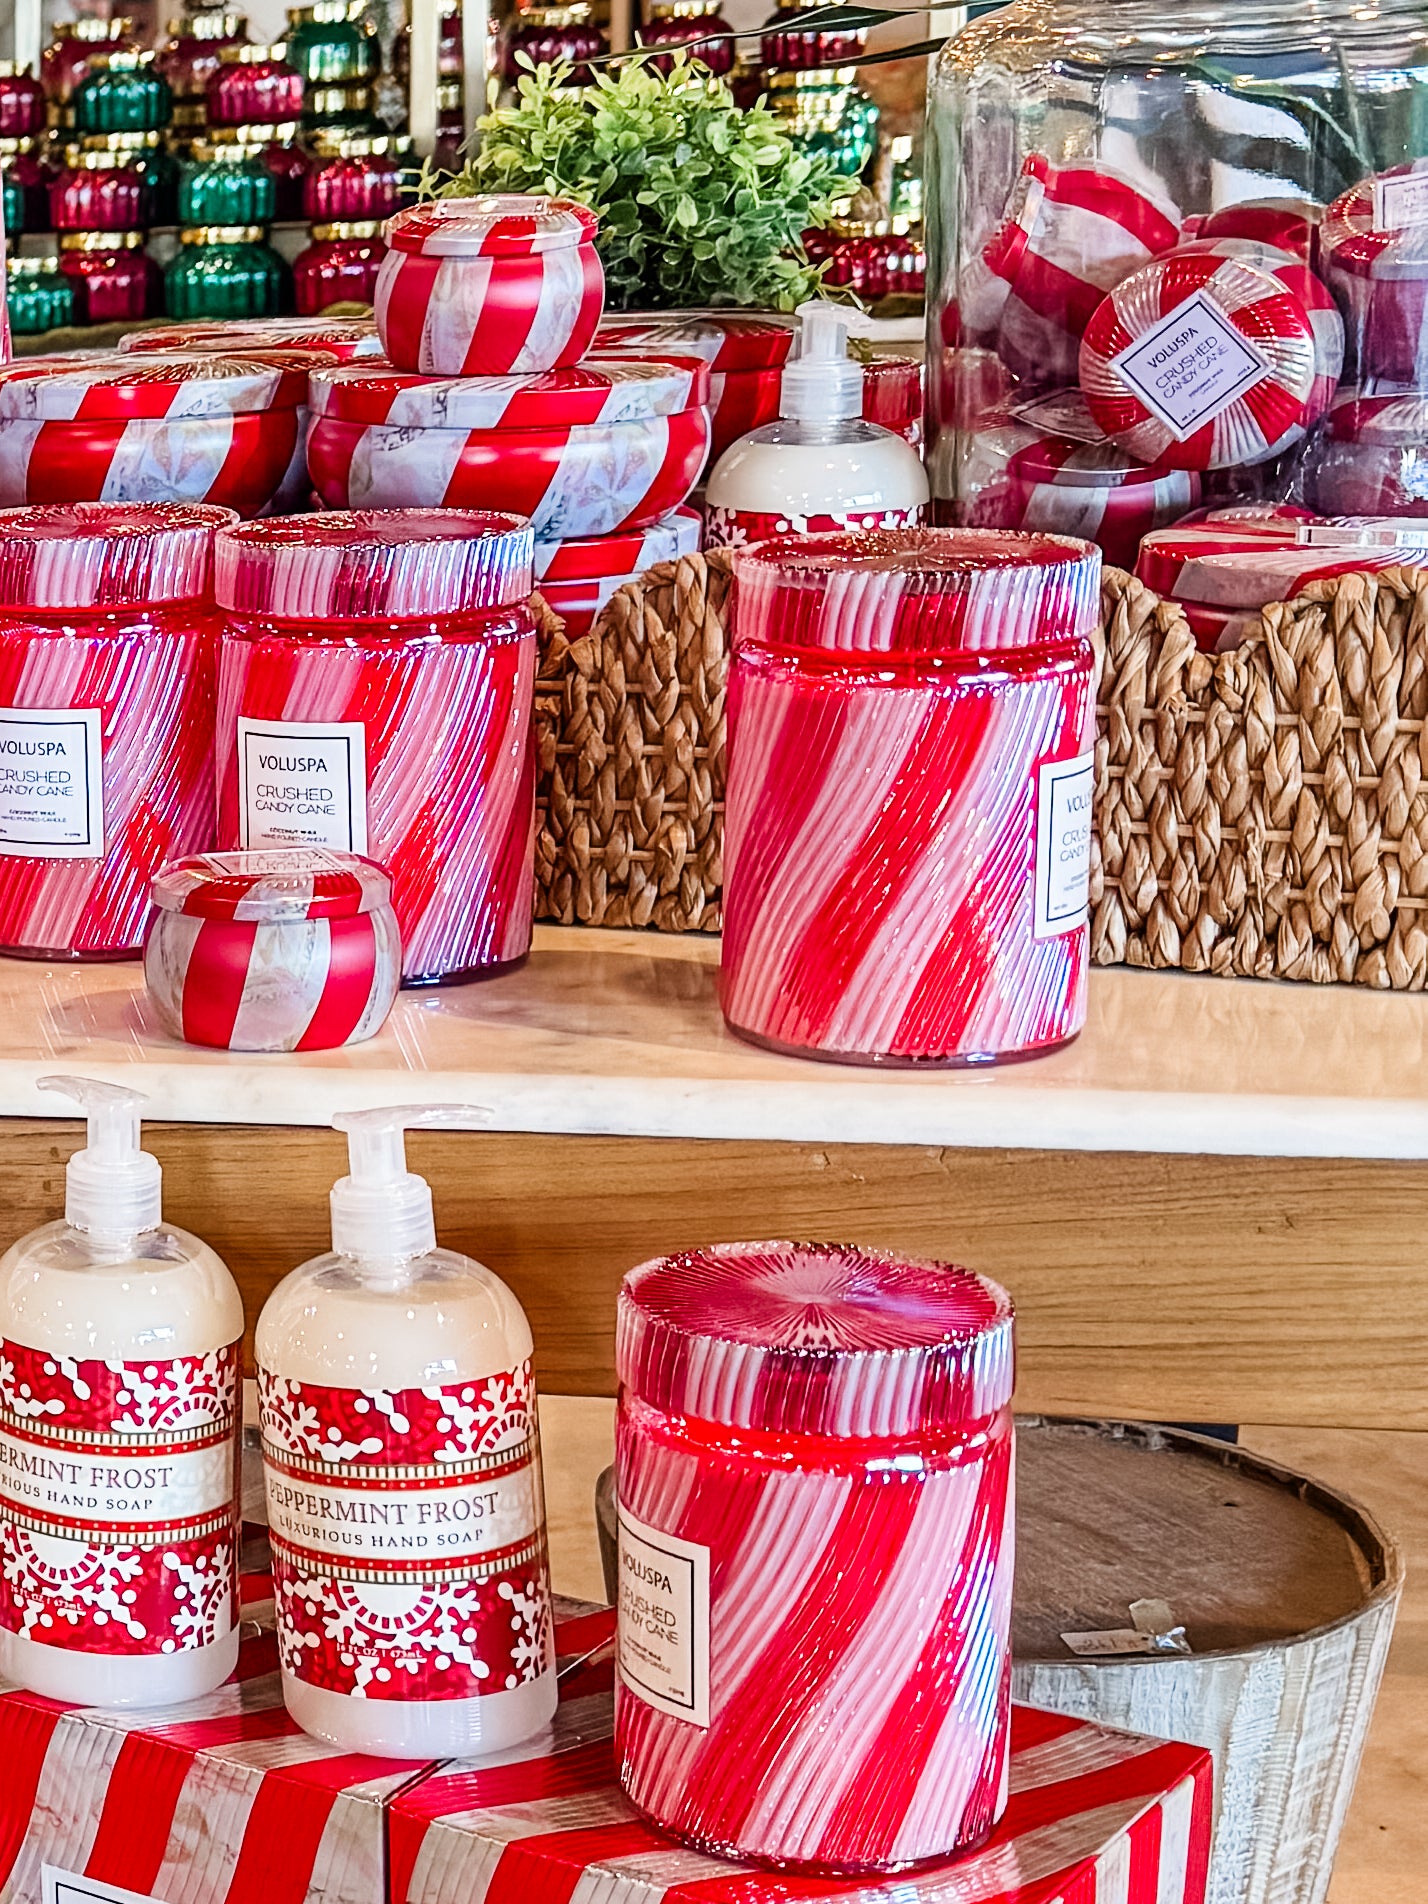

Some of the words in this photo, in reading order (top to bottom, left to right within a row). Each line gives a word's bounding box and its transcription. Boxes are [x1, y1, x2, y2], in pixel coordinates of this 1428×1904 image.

[1147, 327, 1199, 368] VOLUSPA
[1156, 336, 1217, 388] CRUSHED
[259, 755, 327, 772] VOLUSPA
[37, 786, 74, 796] CANE
[257, 784, 332, 801] CRUSHED
[256, 800, 293, 814] CANDY
[297, 804, 336, 815] CANE
[1063, 825, 1088, 846] CRUS
[90, 1467, 173, 1488] FROST
[48, 1491, 97, 1508] HAND
[106, 1499, 153, 1510] SOAP
[269, 1479, 407, 1525] PEPPERMINT
[417, 1492, 498, 1524] FROST
[279, 1515, 362, 1545] LUXURIOUS
[372, 1536, 428, 1547] HAND
[437, 1529, 483, 1545] SOAP
[621, 1549, 672, 1594] VOLUSPA
[646, 1620, 678, 1645] CANE
